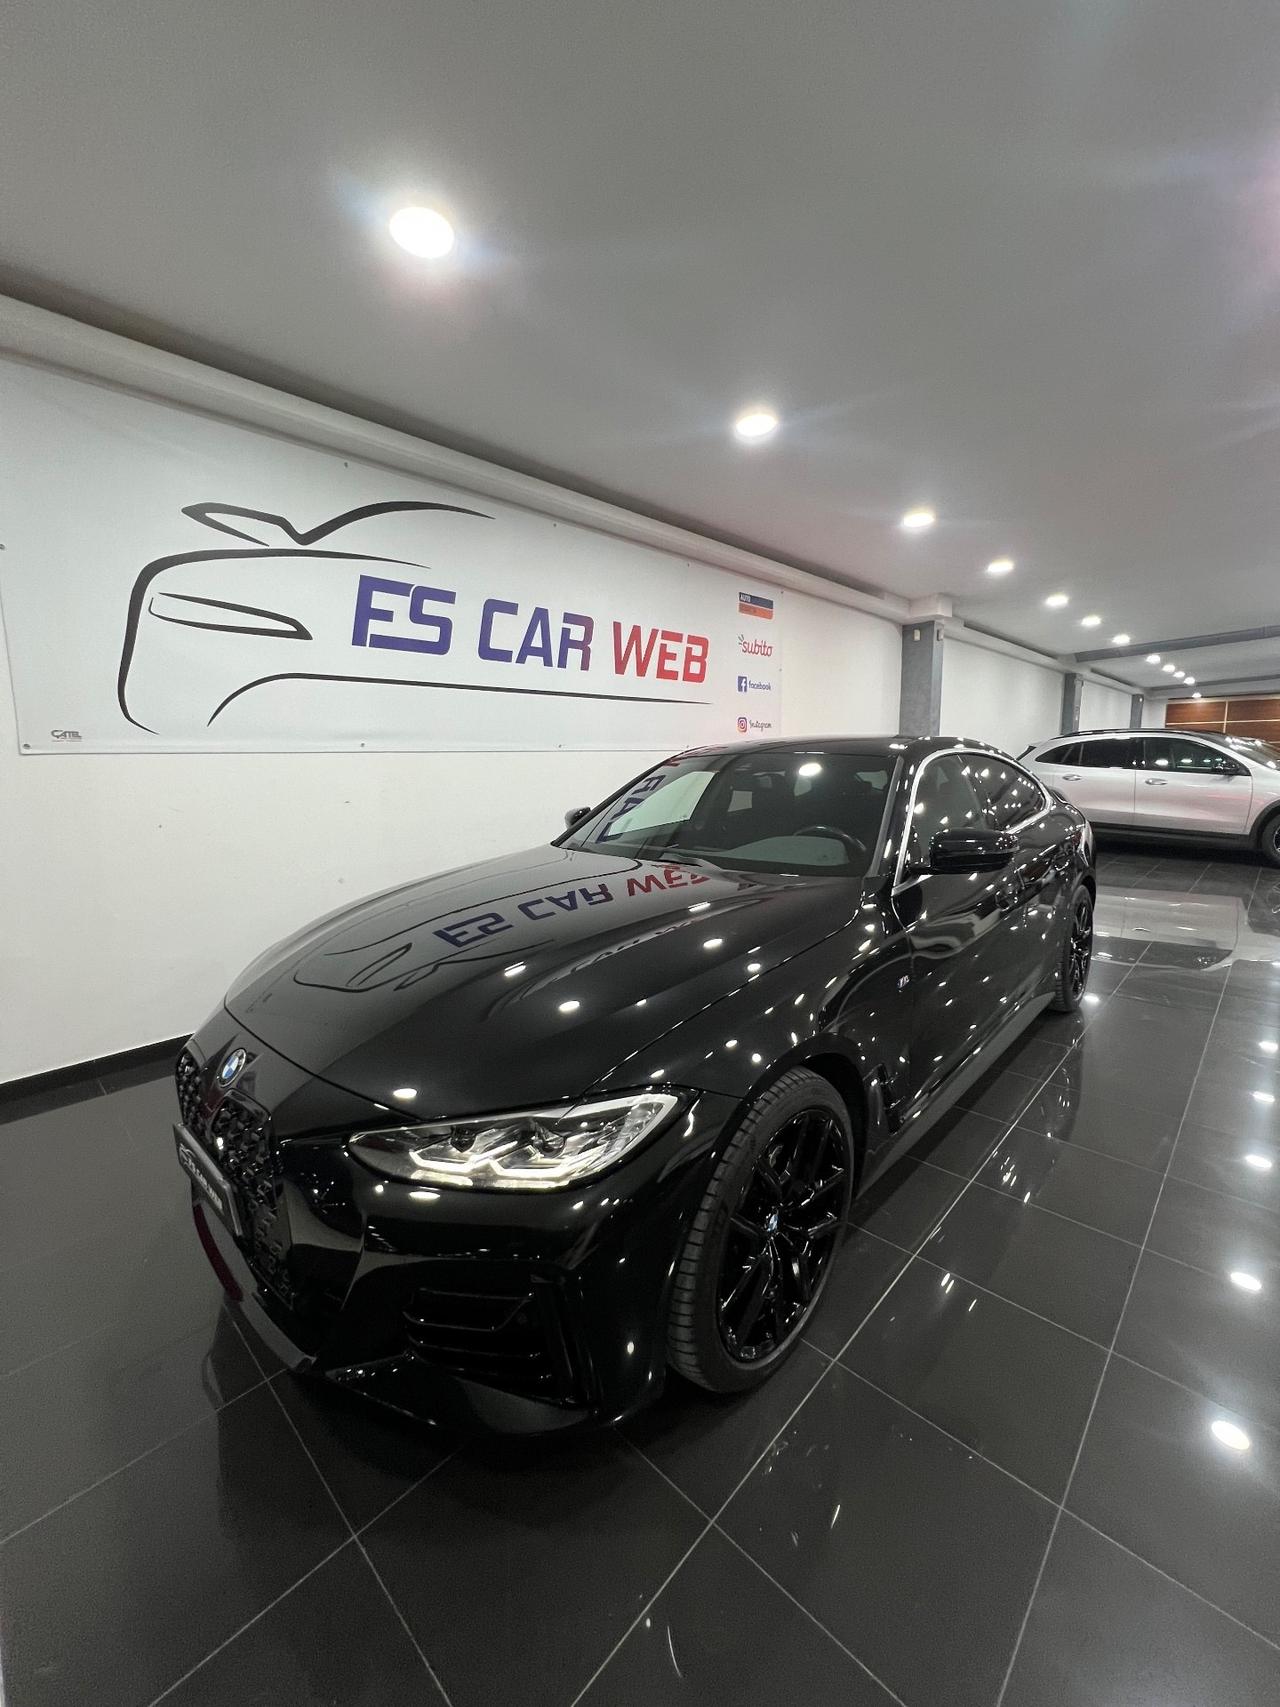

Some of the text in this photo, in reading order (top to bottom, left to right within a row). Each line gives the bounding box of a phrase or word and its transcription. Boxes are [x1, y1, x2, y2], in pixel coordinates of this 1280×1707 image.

[352, 574, 709, 684] ES CAR WEB
[741, 638, 773, 657] subito
[748, 680, 771, 691] facebook
